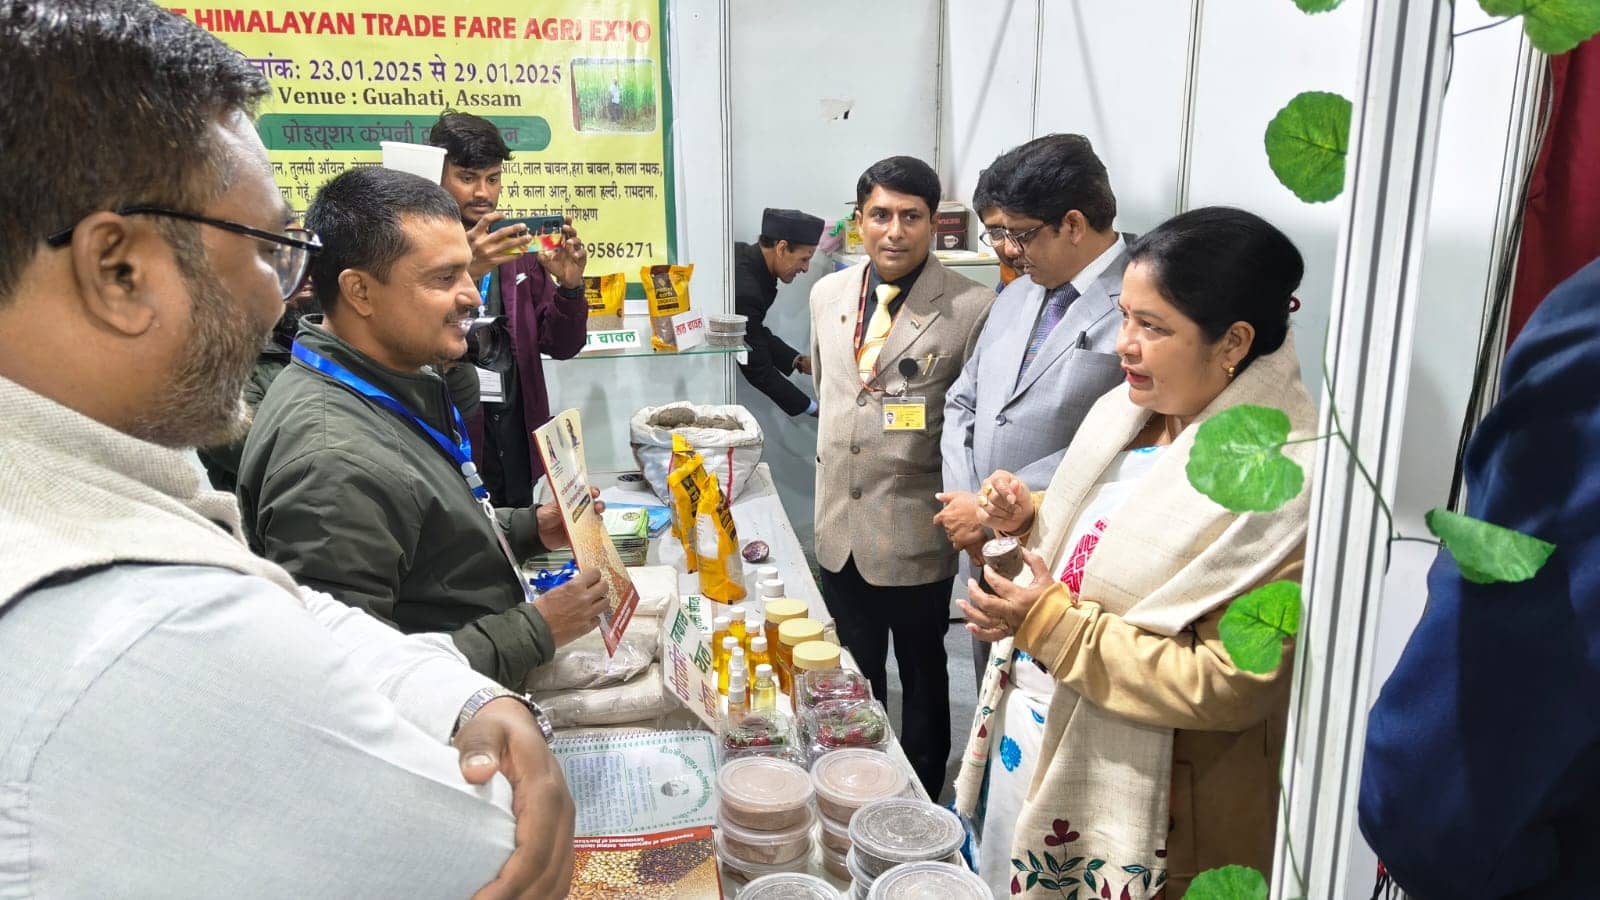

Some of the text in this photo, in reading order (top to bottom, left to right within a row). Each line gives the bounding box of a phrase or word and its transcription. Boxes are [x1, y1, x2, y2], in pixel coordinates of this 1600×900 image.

[194, 8, 652, 43] HIMALAYAN TRADE FARE AGRI EXPO
[310, 59, 423, 82] 23.01.2025
[429, 54, 447, 82] से
[454, 62, 561, 85] 29.01.2025
[278, 86, 346, 105] Venue
[363, 87, 450, 109] Guahati,
[455, 90, 522, 107] Assam
[288, 156, 315, 180] तुलसी
[586, 163, 613, 176] चावल,
[615, 163, 637, 176] काला
[639, 163, 662, 177] नमक,
[523, 186, 545, 198] काला
[549, 186, 571, 203] आलू,
[574, 186, 596, 198] काला
[624, 185, 658, 200] रामदाना,
[597, 331, 636, 344] चावल
